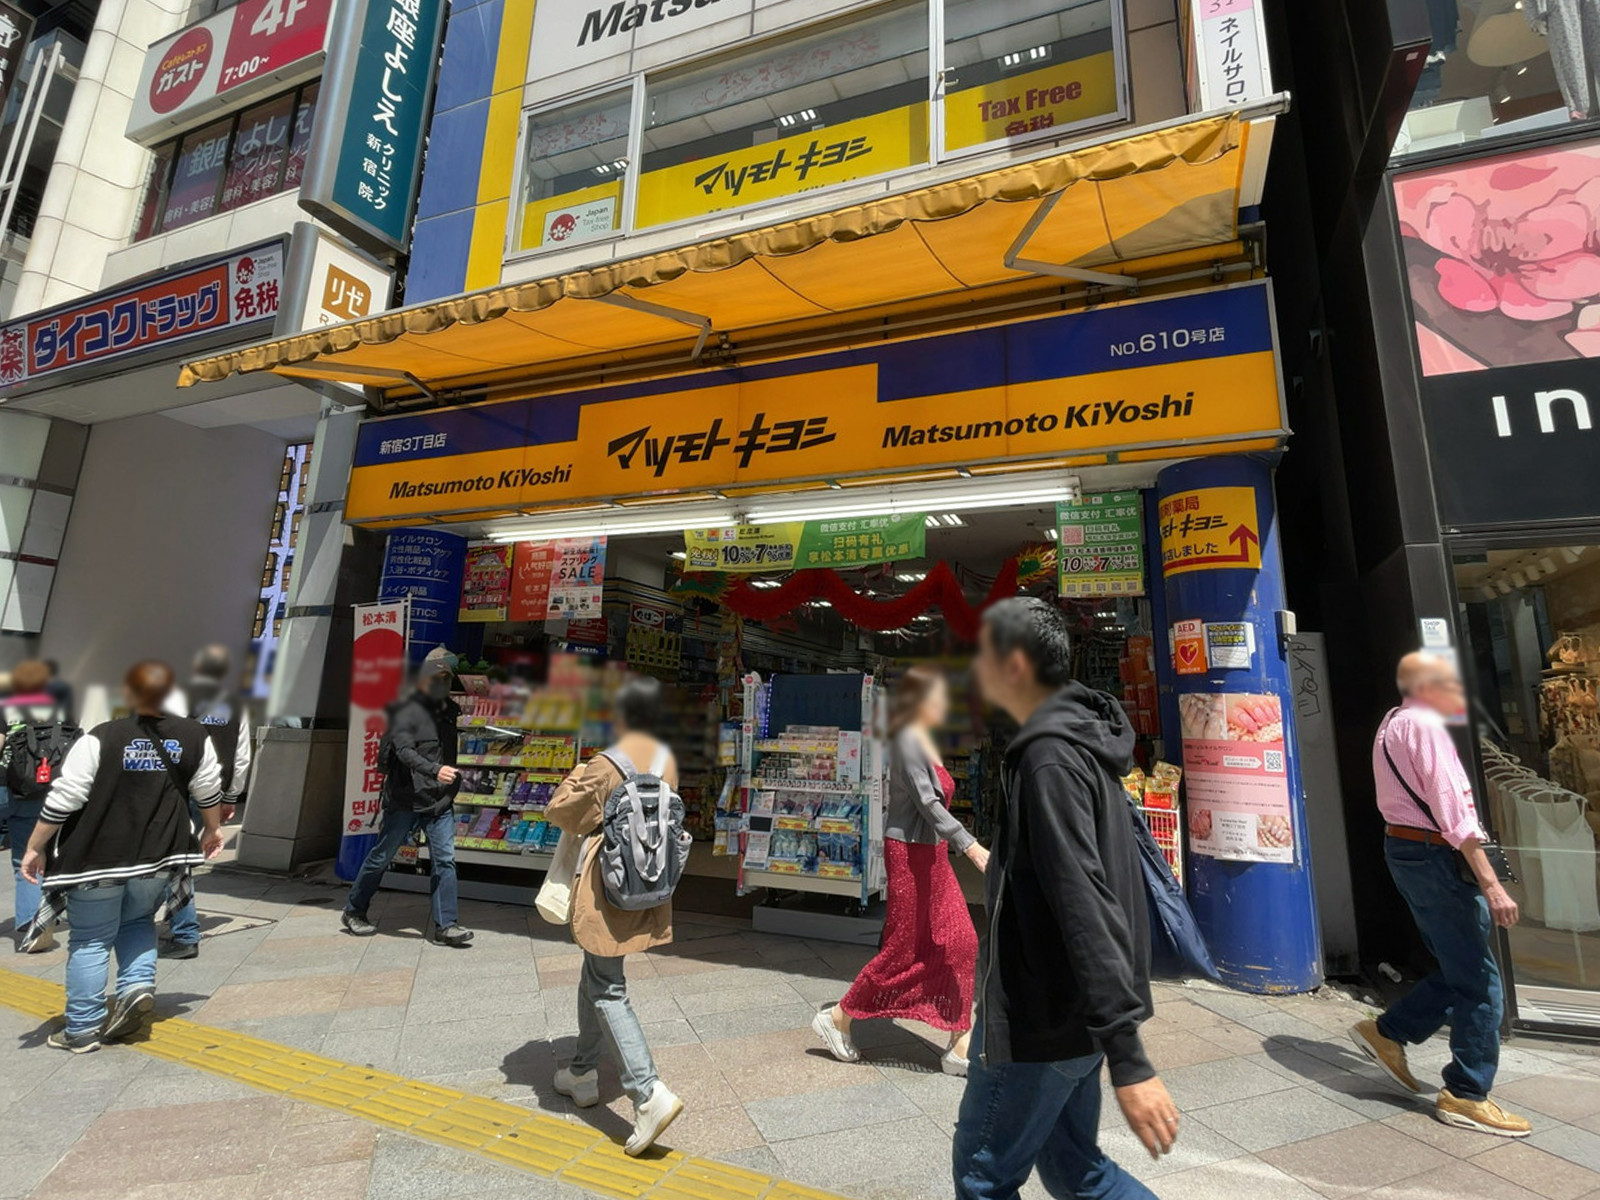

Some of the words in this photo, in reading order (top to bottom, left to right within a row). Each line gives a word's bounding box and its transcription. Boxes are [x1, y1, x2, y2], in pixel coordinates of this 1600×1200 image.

[577, 0, 721, 47] Mats
[156, 59, 203, 95] ガスト
[978, 100, 1020, 122] Tax
[1026, 81, 1081, 111] Free
[358, 133, 382, 202] 新宿院
[374, 143, 396, 210] クリニック
[694, 136, 873, 197] マツモトキヨシ
[586, 207, 609, 217] Japan
[234, 278, 280, 321] 免税
[330, 277, 365, 317] リゼ
[33, 279, 222, 369] ダイコクドラッグ
[1110, 327, 1225, 357] NO.610号店
[881, 413, 1059, 449] Matsumoto
[1064, 392, 1194, 430] KiYoshi
[379, 432, 448, 456] 新宿3丁目店
[607, 412, 837, 478] マツモトキヨシ
[389, 474, 496, 499] Matsumoto
[497, 464, 574, 489] KiYoshi
[384, 585, 428, 597] メイク用品
[558, 566, 596, 580] SALE
[362, 610, 397, 627] 松本清
[1177, 622, 1196, 634] AED
